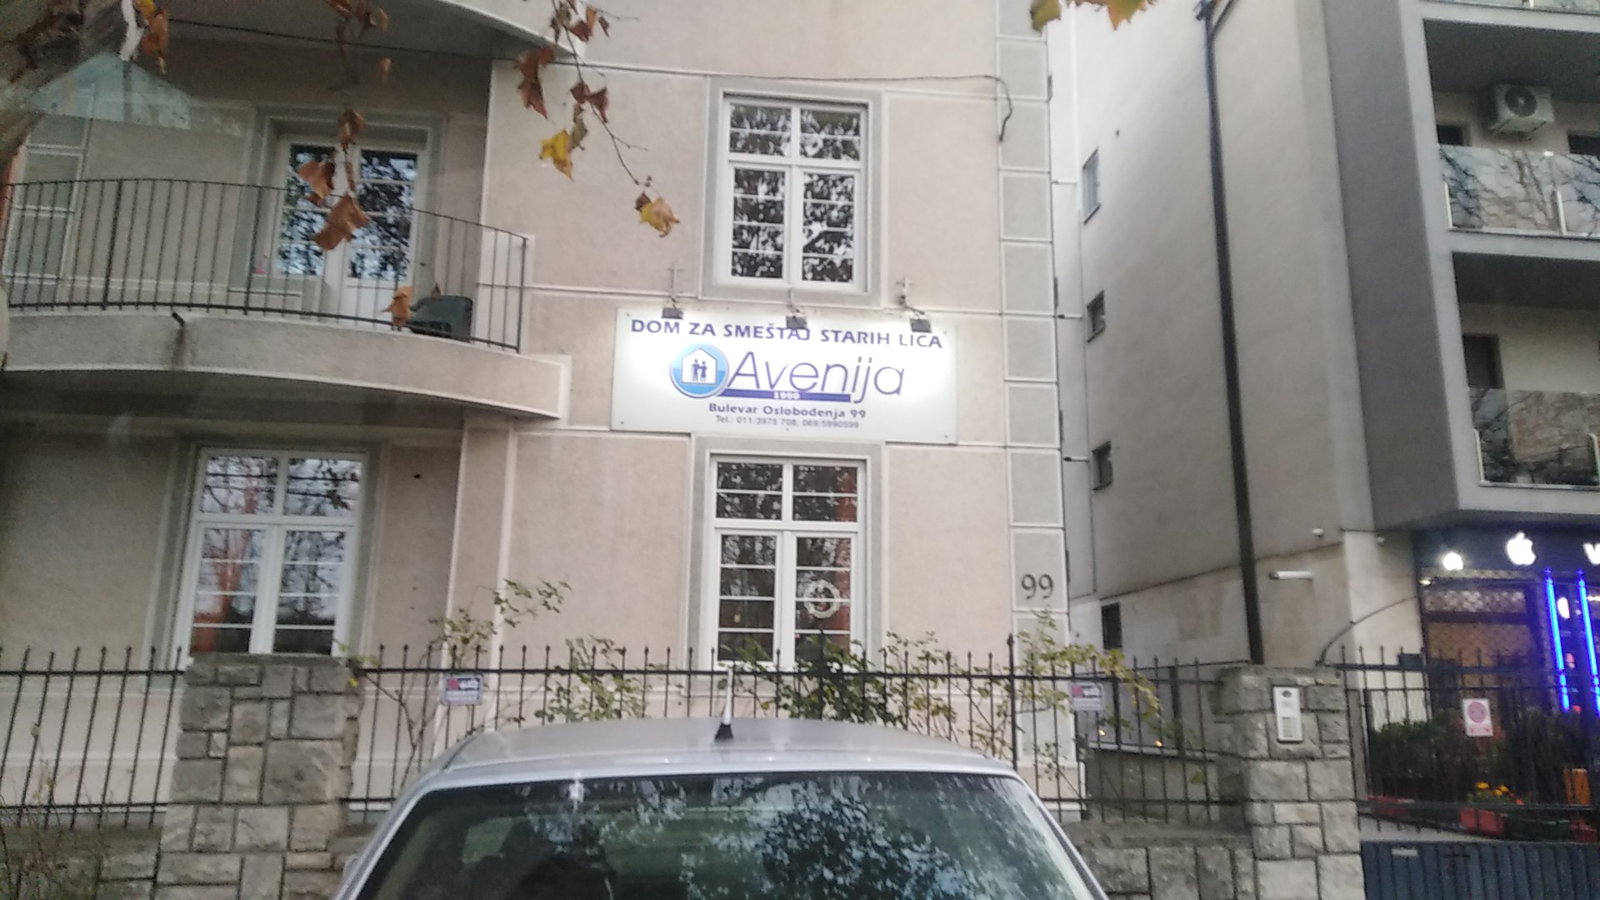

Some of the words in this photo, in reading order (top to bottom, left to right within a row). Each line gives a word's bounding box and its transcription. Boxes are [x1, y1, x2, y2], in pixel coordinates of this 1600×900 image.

[631, 319, 680, 334] DOM
[689, 322, 716, 336] ZA
[723, 323, 810, 341] SMEŠTAJ
[820, 329, 890, 345] STARIH
[899, 333, 943, 348] LICA
[727, 351, 905, 404] Avenija
[708, 402, 758, 414] Bulevar
[850, 409, 866, 418] 99
[1021, 573, 1054, 600] 99
